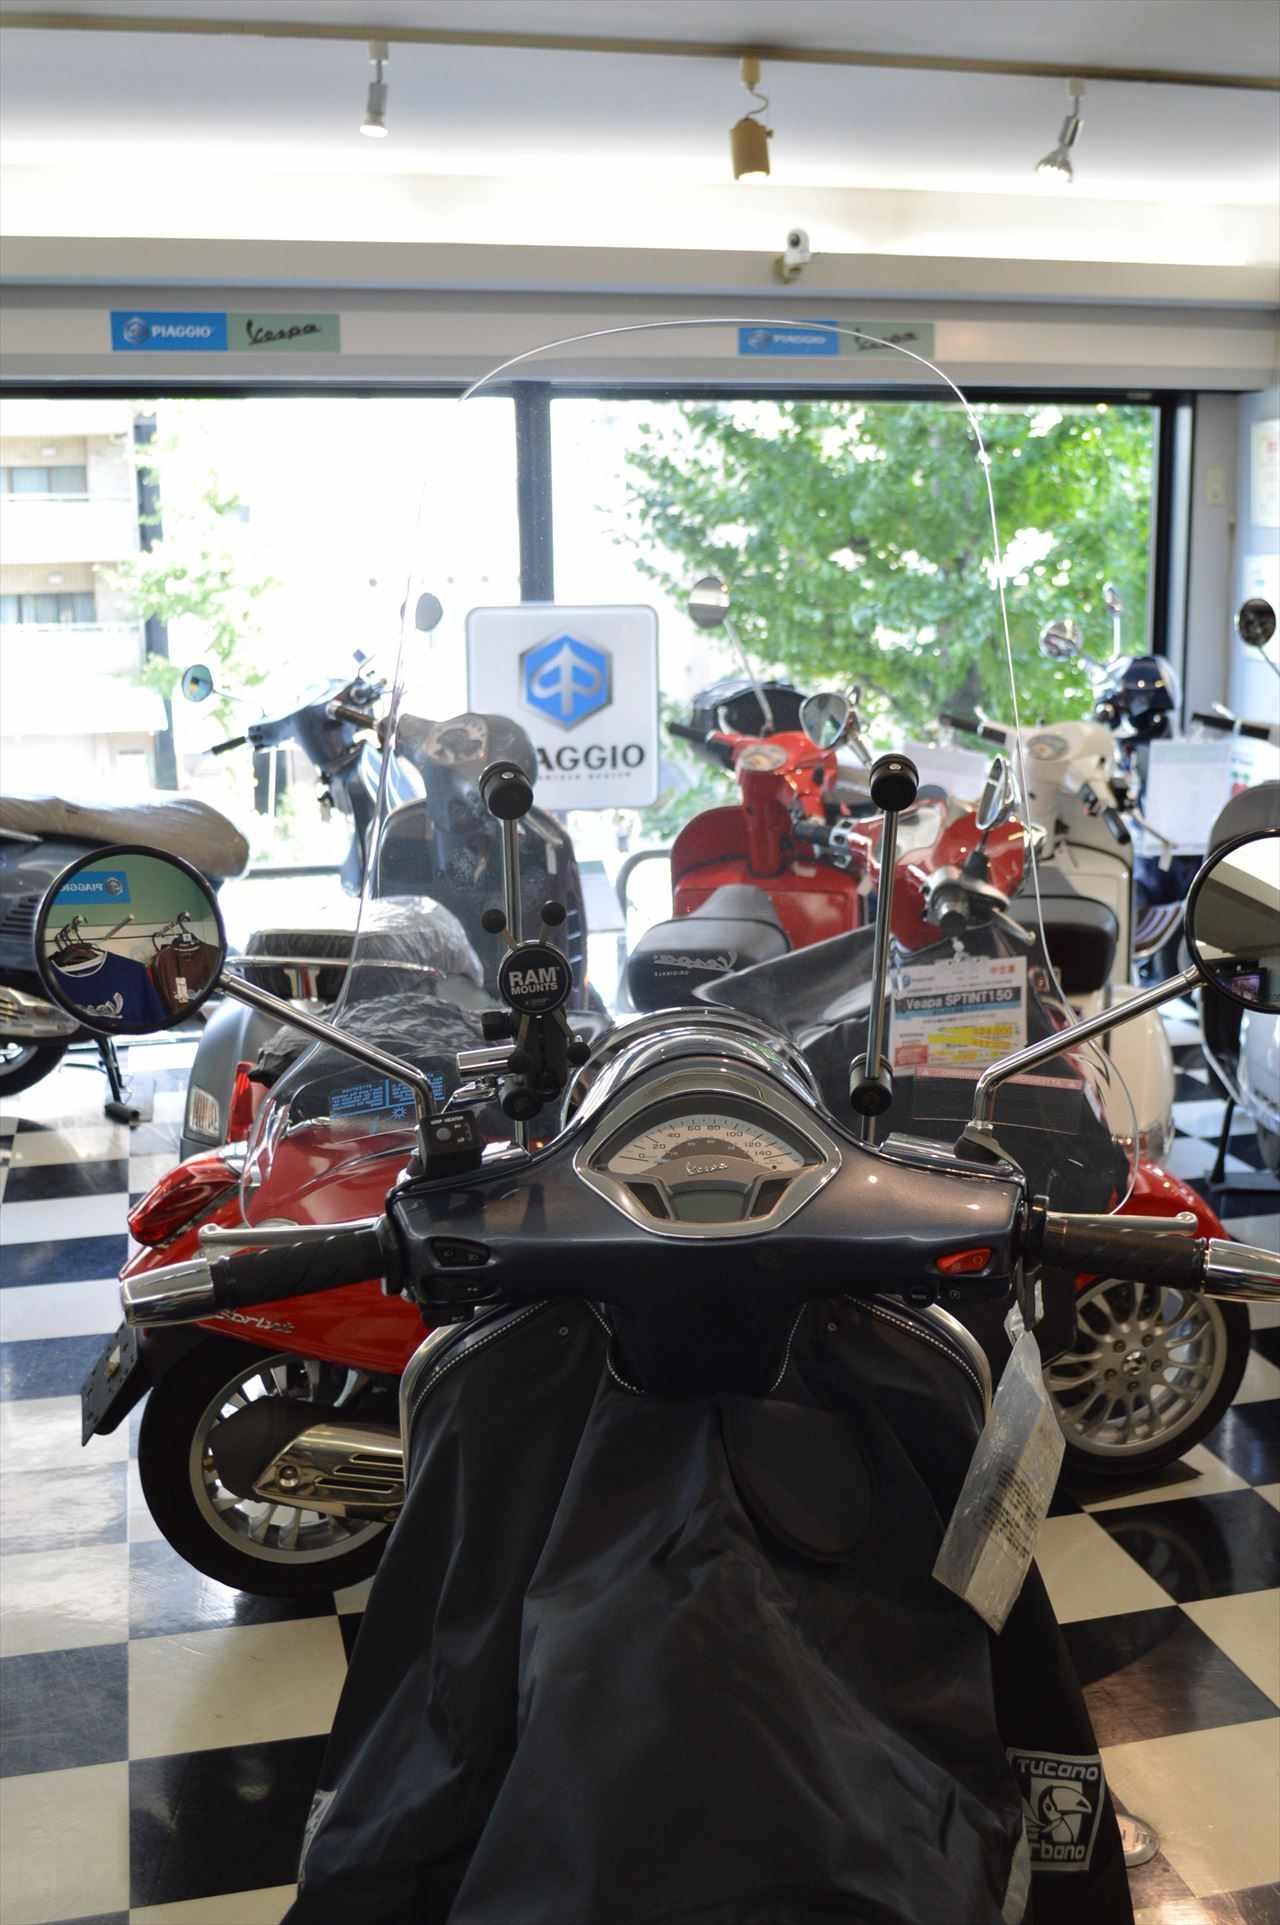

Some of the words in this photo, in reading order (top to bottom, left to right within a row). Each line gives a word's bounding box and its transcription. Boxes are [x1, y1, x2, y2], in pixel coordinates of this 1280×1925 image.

[151, 325, 212, 338] PIAGGIO
[246, 319, 321, 346] Vespa
[537, 744, 646, 771] AGGIO
[508, 966, 558, 986] RAM
[511, 982, 558, 996] MOUNTS
[706, 1124, 721, 1132] 80
[685, 1161, 728, 1176] Vespa
